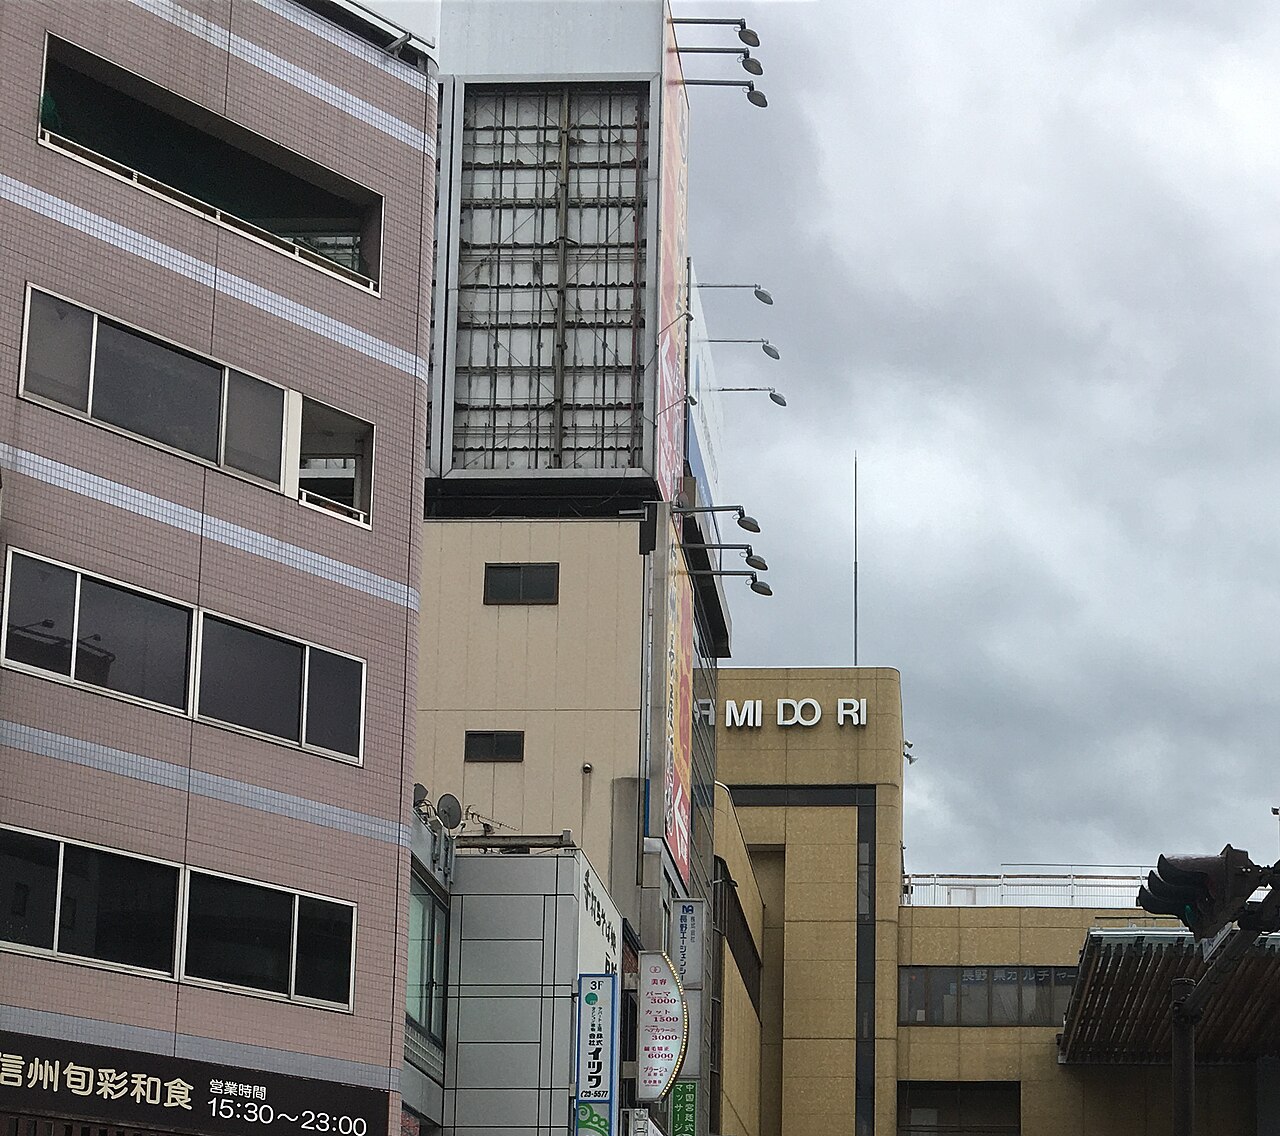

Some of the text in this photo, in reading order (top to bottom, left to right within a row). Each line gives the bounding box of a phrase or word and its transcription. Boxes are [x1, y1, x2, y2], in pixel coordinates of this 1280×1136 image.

[725, 698, 867, 727] MI DO RI
[590, 981, 604, 990] 3F
[0, 1053, 194, 1110] 信州旬彩和食
[588, 1047, 602, 1088] イツワ
[209, 1079, 266, 1101] 営業時間
[675, 1084, 683, 1132] マッサージ
